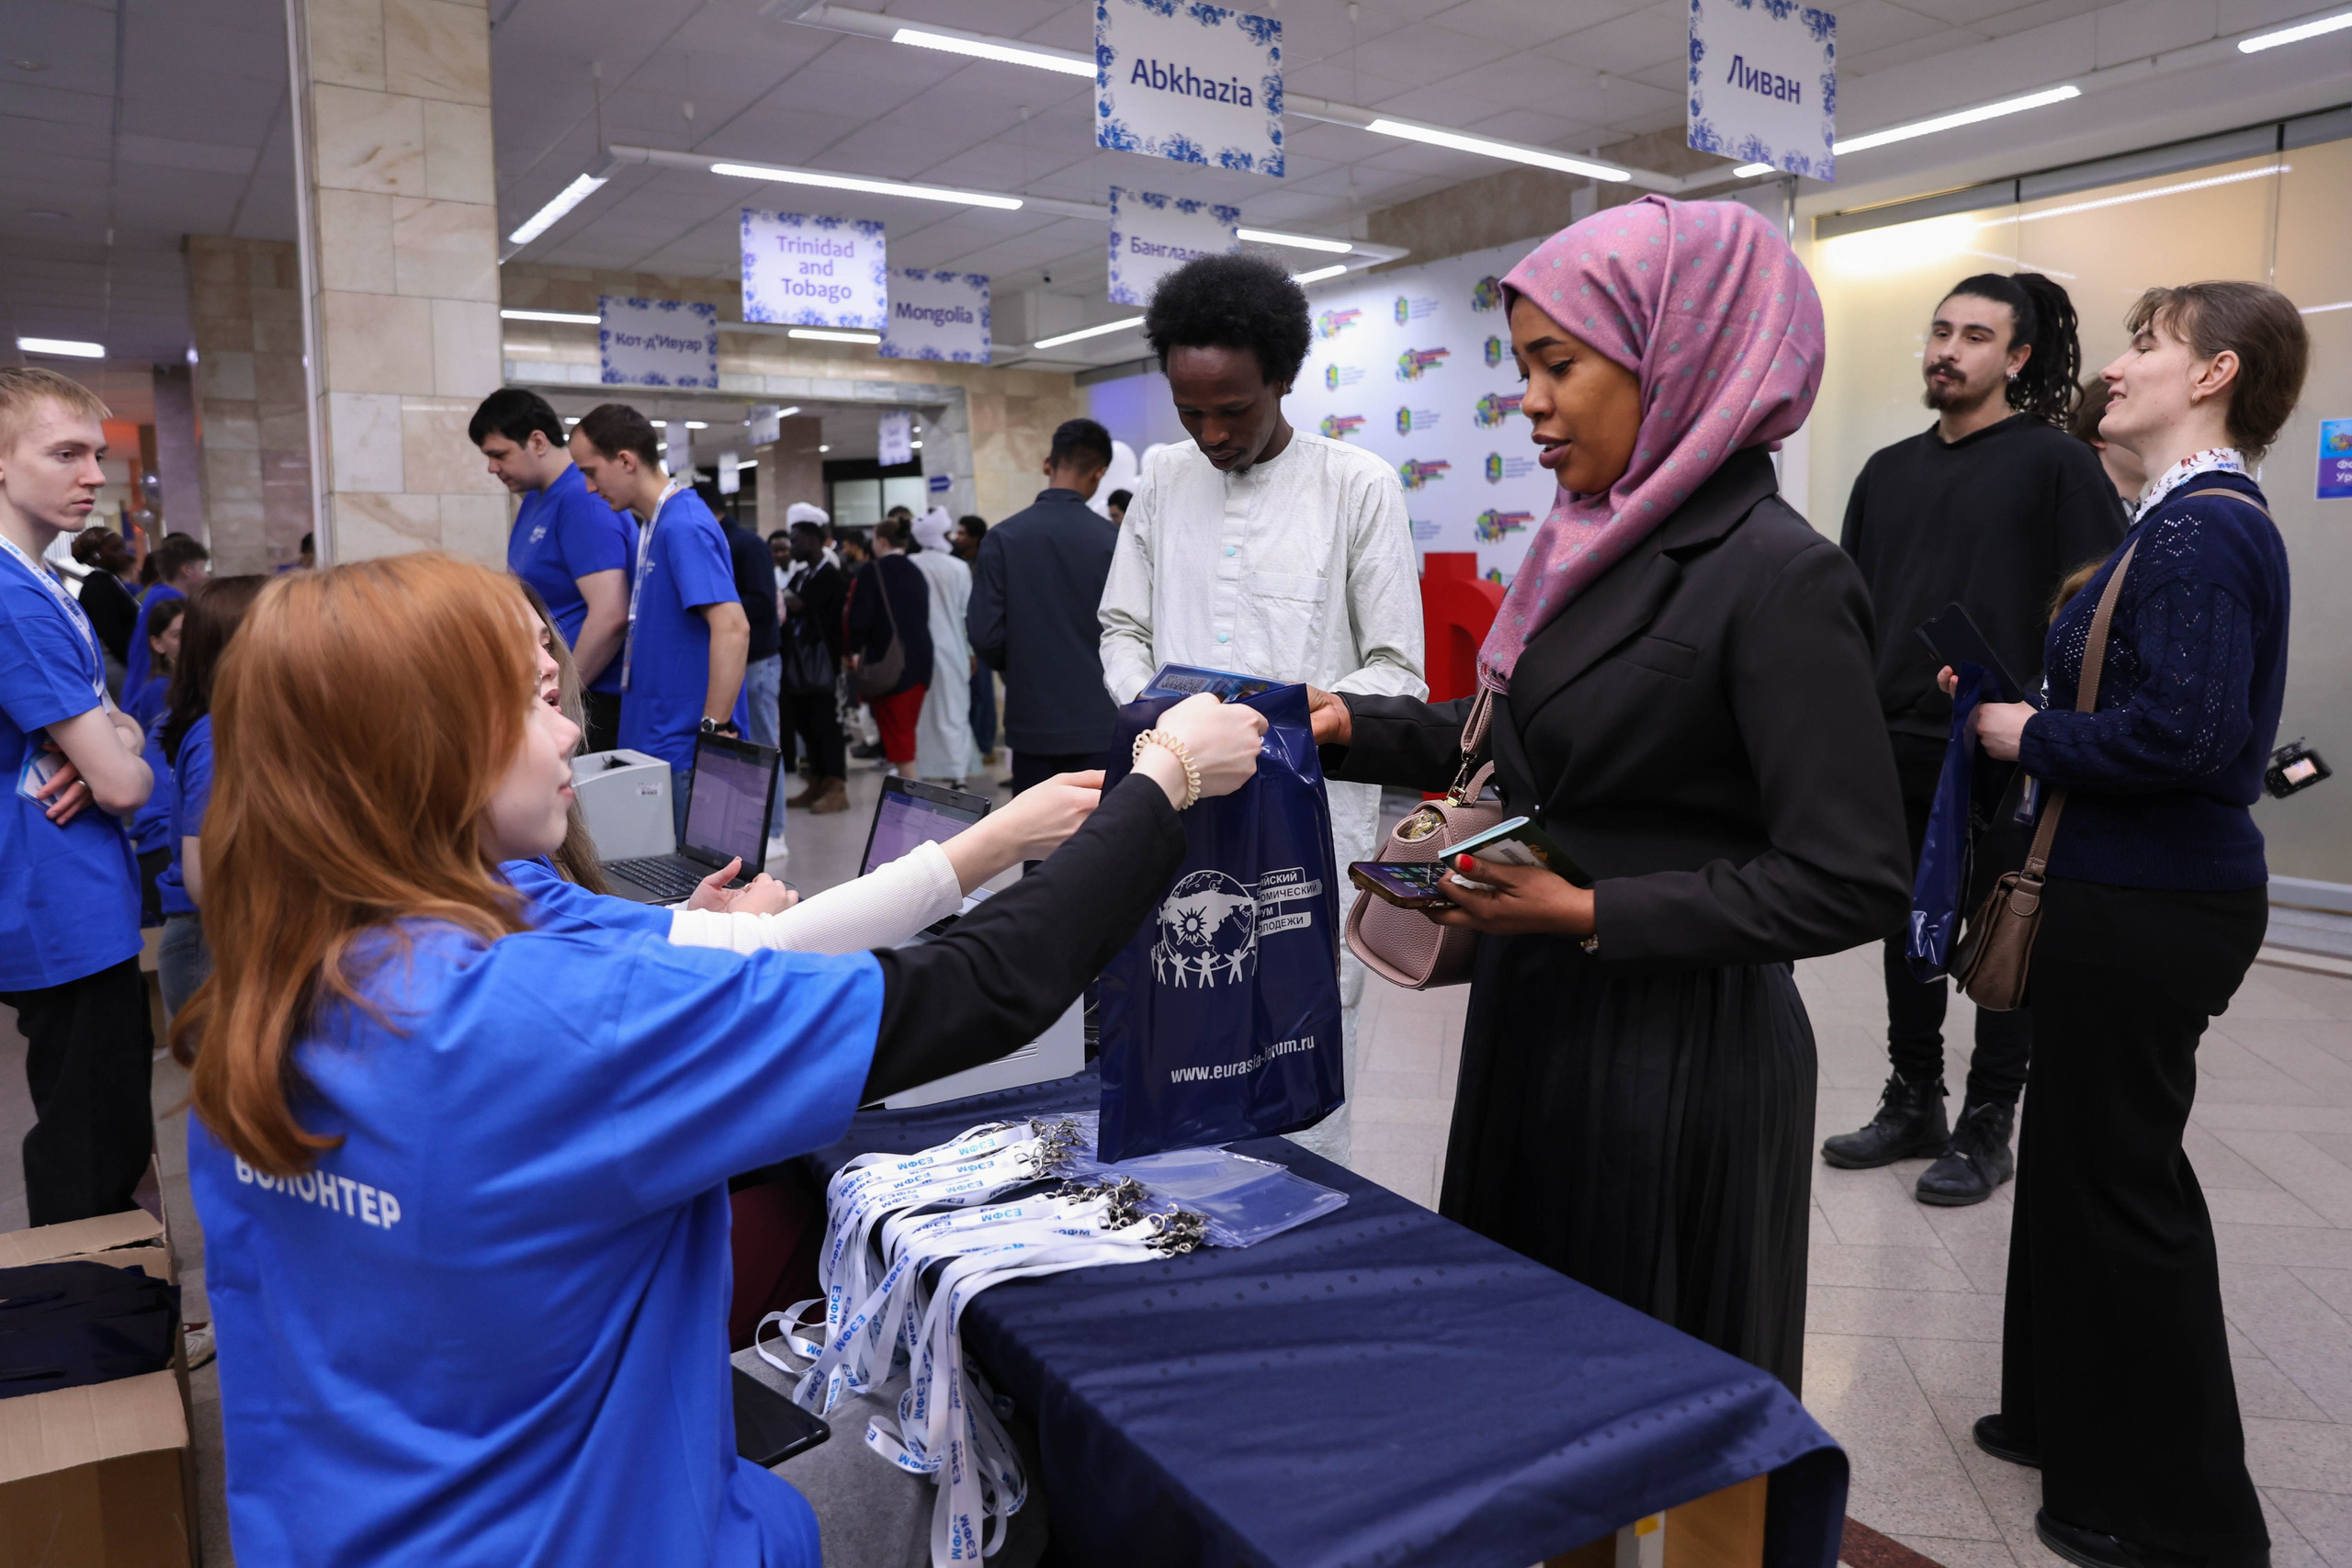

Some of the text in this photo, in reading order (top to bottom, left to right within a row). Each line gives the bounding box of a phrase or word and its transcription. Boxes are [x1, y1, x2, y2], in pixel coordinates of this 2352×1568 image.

[1130, 58, 1253, 108] Abkhazia
[1727, 54, 1801, 106] Ливан
[776, 235, 855, 259] Trinidad
[798, 260, 834, 276] and
[781, 278, 853, 305] Tobago
[895, 301, 975, 328] Mongolia
[616, 332, 704, 355] Кот-д'Ивуар
[1260, 882, 1318, 903] ОМИЧЕСКИЙ
[1260, 906, 1274, 918] УМ
[1170, 1035, 1316, 1084] www.eurasia-forum.ru
[958, 1138, 996, 1156] ЕЭФМ
[898, 1156, 935, 1171] ЕЭФМ
[956, 1160, 995, 1174] ЕЭФМ
[840, 1170, 873, 1199] ЕЭФМ
[893, 1172, 932, 1190] ЕЭФМ
[945, 1179, 985, 1194] ЕЭФМ
[881, 1194, 920, 1209] ЕЭФМ
[981, 1208, 1023, 1223] ЕЭФМ
[1053, 1228, 1091, 1236] ЭФМ
[881, 1255, 910, 1293] ЕЭФМ
[829, 1284, 842, 1325] ЕЭФМ
[841, 1296, 853, 1328] ЕЭФ
[833, 1314, 867, 1353] ЕЭФМ
[906, 1301, 918, 1347] ЕЭФМ
[807, 1369, 826, 1402] ЕЭФМ
[913, 1377, 926, 1420] ЕЭФМ
[951, 1514, 963, 1561] ЭФМ
[960, 1514, 978, 1561] ЕЭФМ
